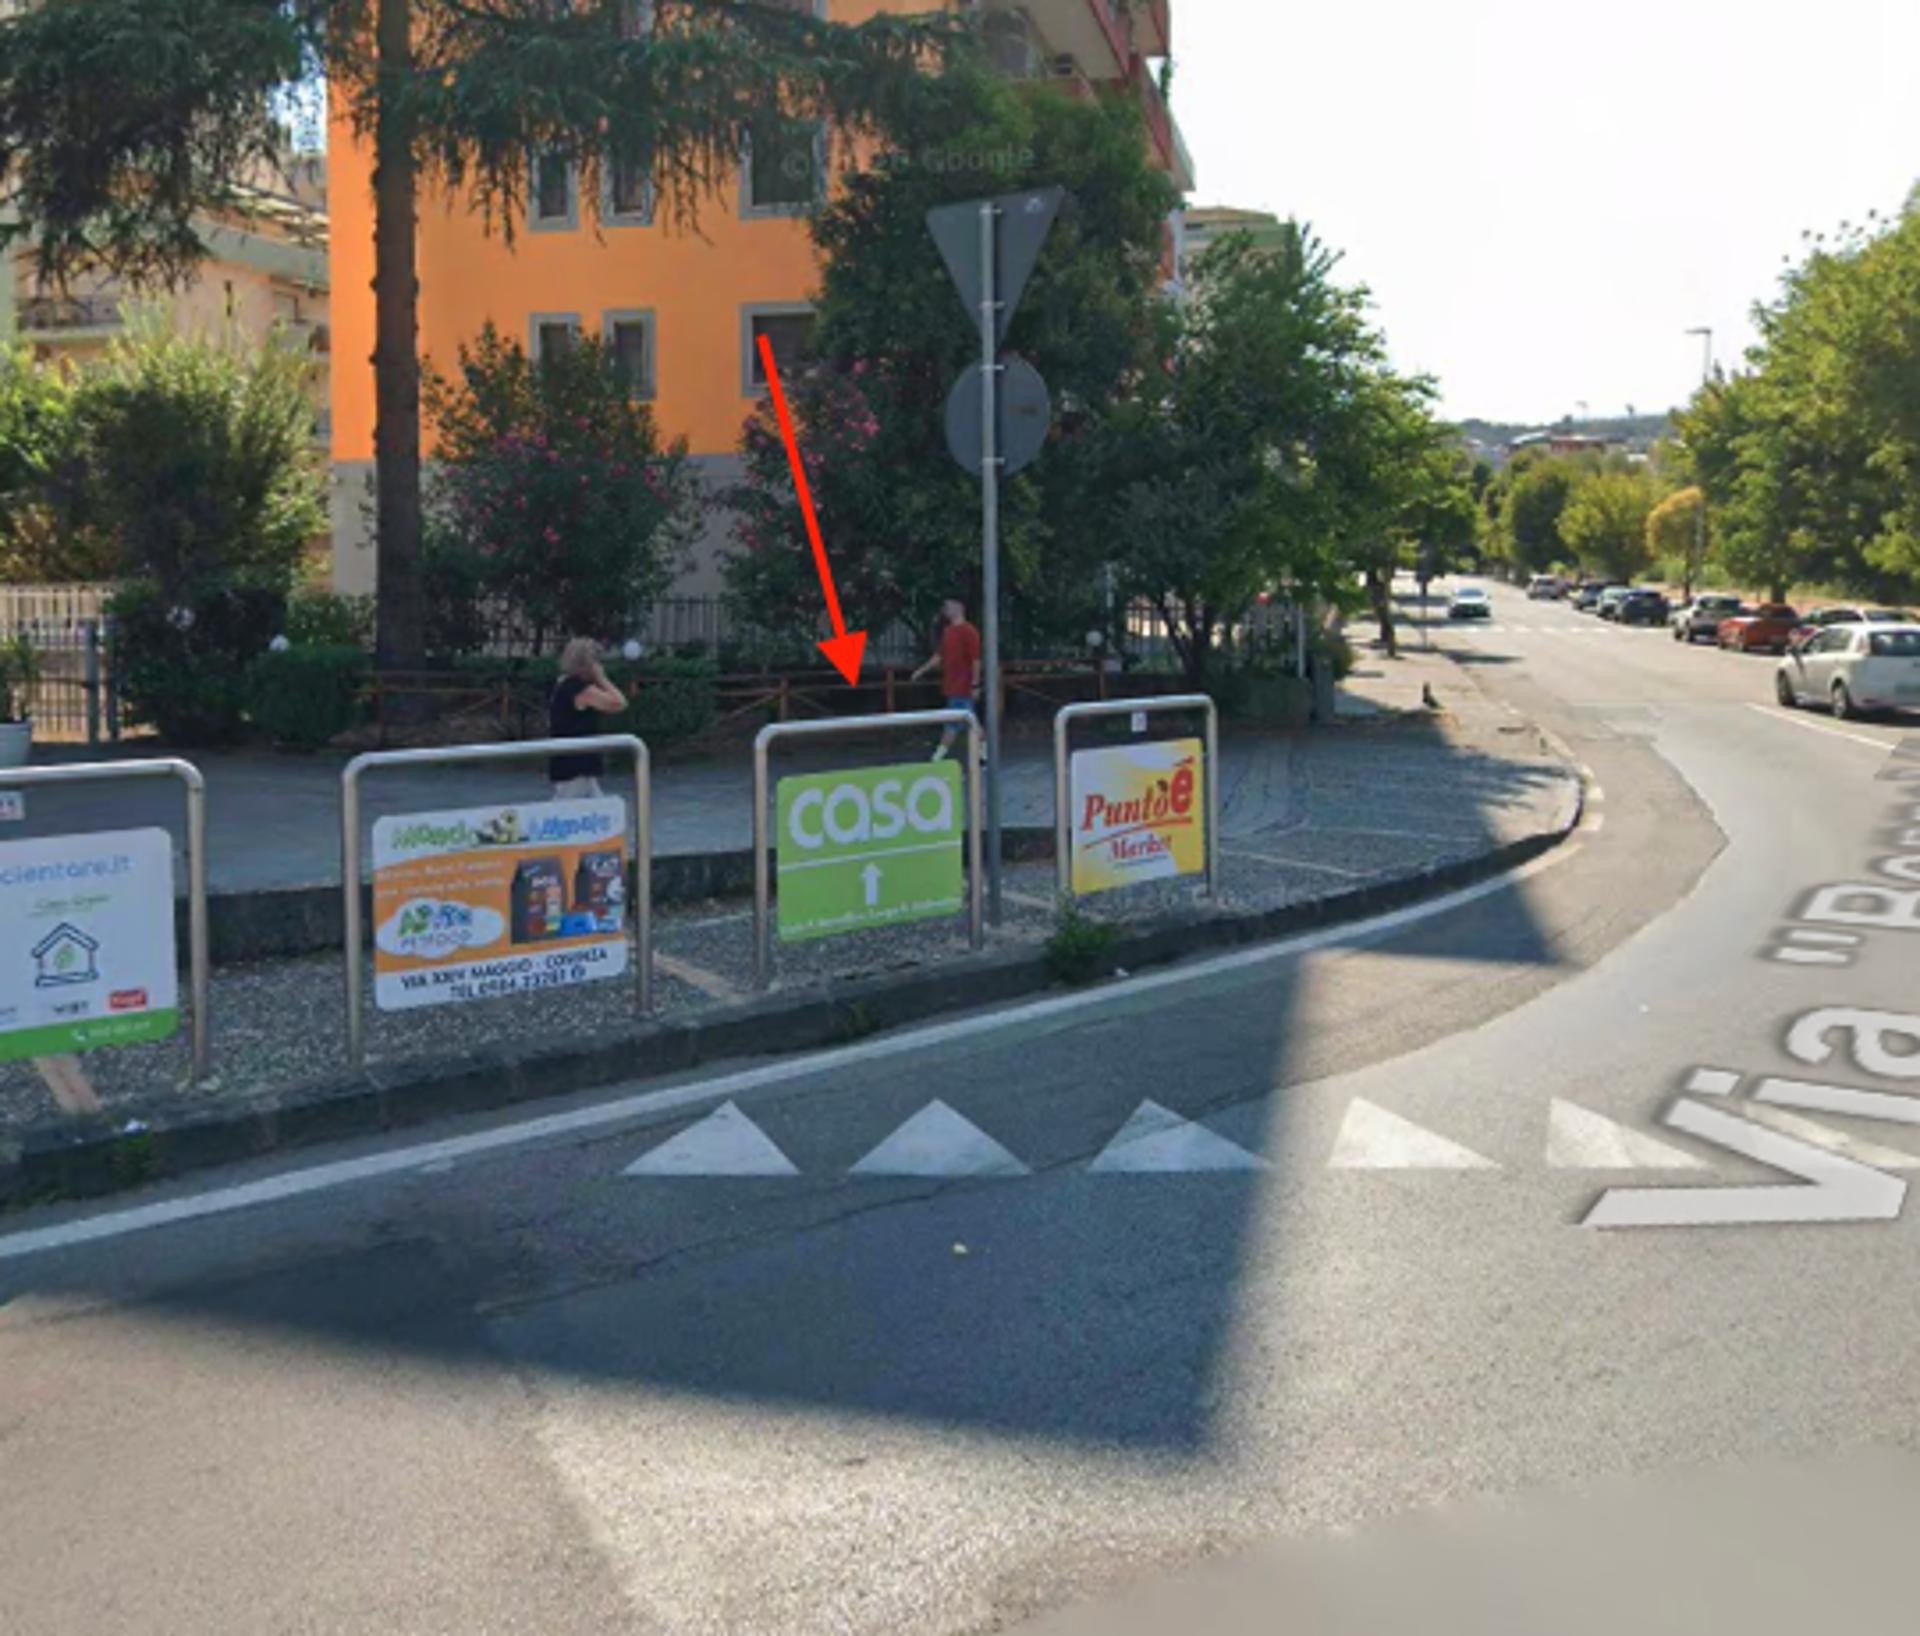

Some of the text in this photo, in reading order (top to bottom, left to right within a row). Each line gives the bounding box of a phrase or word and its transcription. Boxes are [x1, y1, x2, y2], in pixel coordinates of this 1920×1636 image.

[788, 775, 953, 850] casa
[401, 974, 428, 991] VIA
[433, 968, 465, 985] XXIV
[472, 957, 533, 979] MAGGIO
